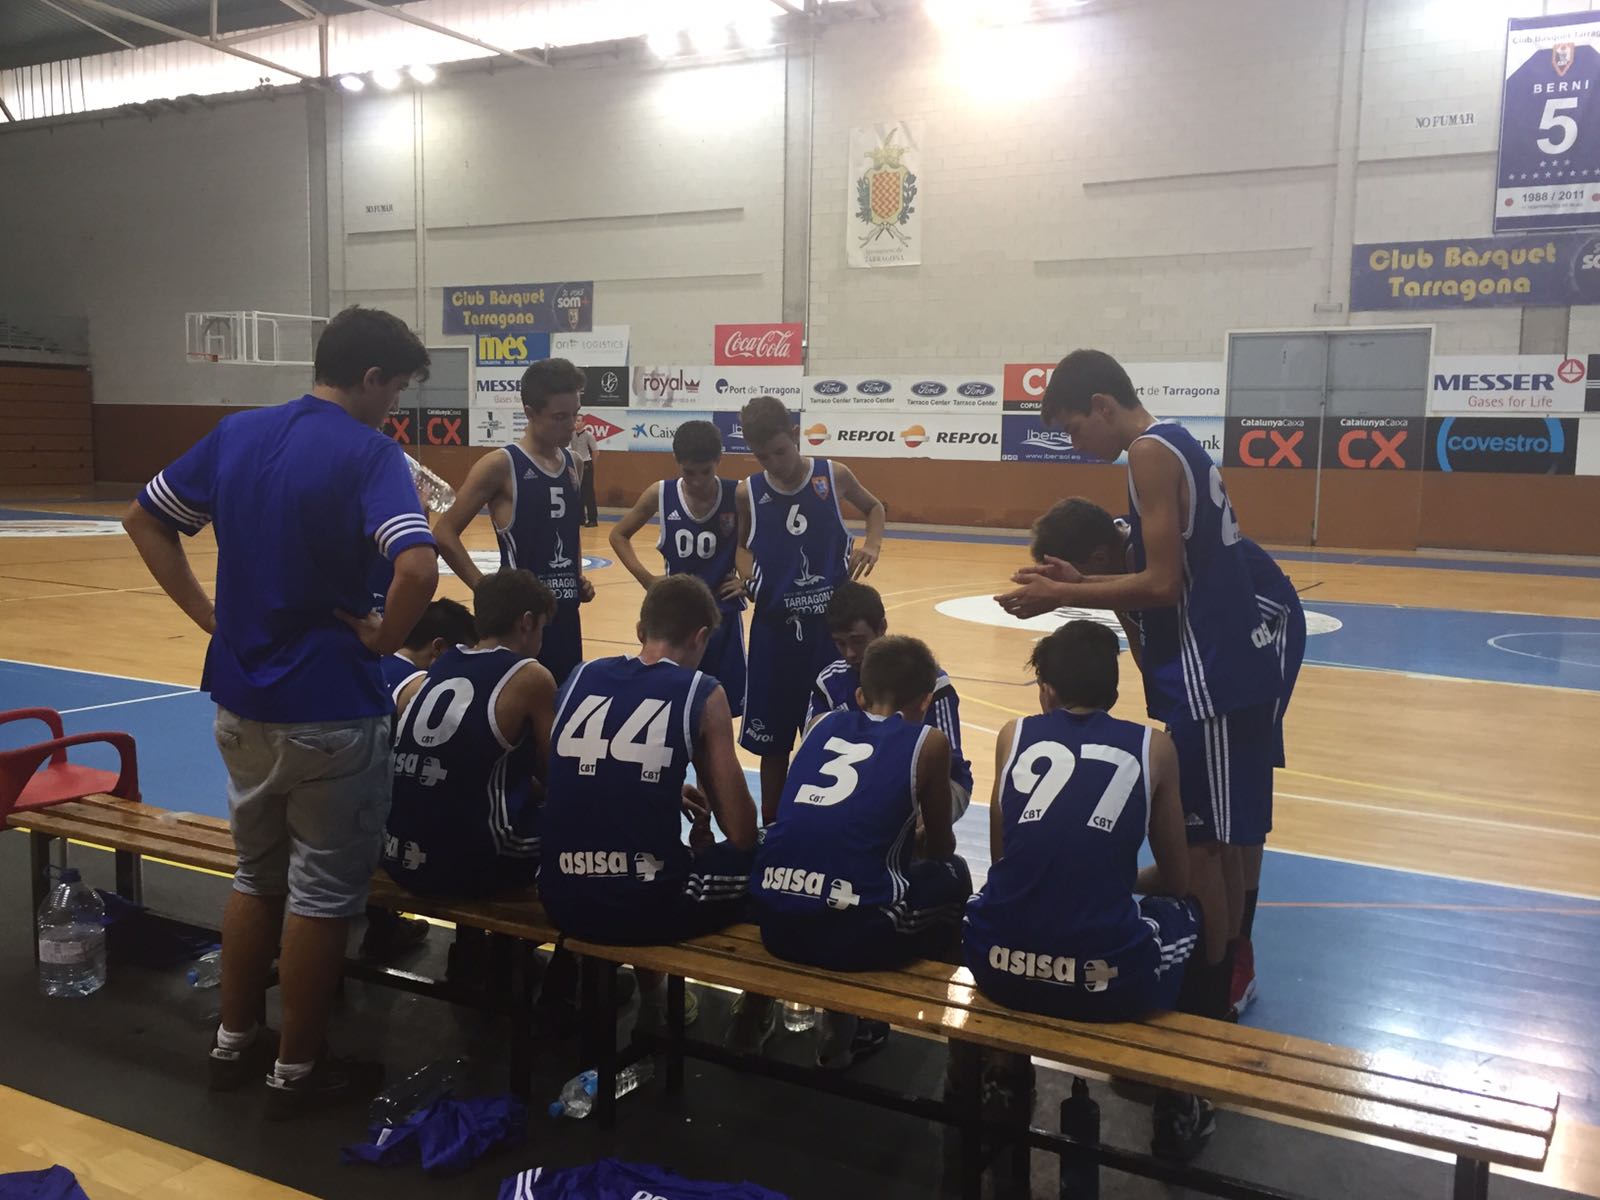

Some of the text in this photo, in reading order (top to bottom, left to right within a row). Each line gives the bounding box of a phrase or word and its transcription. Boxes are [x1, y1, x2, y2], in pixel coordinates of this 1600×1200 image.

[1533, 80, 1590, 94] BERNI
[1416, 113, 1474, 128] NO FUMAR
[1536, 97, 1578, 154] 5
[1523, 192, 1548, 202] 1988
[1558, 190, 1584, 201] 2011
[1369, 242, 1556, 271] Club Bàsquet
[1388, 276, 1531, 301] Tarragona
[452, 291, 485, 307] Club
[557, 297, 581, 309] som
[463, 311, 535, 329] Tarragona
[725, 330, 794, 358] Coca-Cola
[477, 380, 521, 392] MESSE
[644, 369, 683, 397] royal
[729, 386, 800, 396] Port de Tarragona
[1434, 374, 1554, 391] MESSER
[1147, 386, 1160, 396] de
[1162, 386, 1220, 398] Tarragona
[1468, 395, 1553, 408] Gases for Life
[427, 417, 462, 445] CX
[1241, 418, 1304, 428] CatalunyaCaixa
[1340, 418, 1408, 428] CatalunyaCaixa
[837, 430, 895, 442] REPSOL
[936, 432, 999, 444] REPSOL
[1027, 429, 1069, 441] Ibers
[1447, 434, 1549, 452] covestro
[1239, 430, 1304, 467] CX
[1338, 430, 1408, 468] CX
[549, 487, 566, 518] 5
[785, 504, 808, 536] 6
[675, 528, 717, 559] 00
[556, 695, 674, 783] 44
[579, 763, 596, 774] CBT
[642, 770, 660, 781] CBT
[794, 736, 874, 806] 3
[1011, 740, 1141, 833] 97
[808, 793, 826, 804] CBT
[1023, 808, 1042, 820] CBT
[1092, 815, 1114, 830] CBT
[559, 851, 628, 875] asisa
[762, 866, 825, 896] asisa
[989, 945, 1076, 983] asisa
